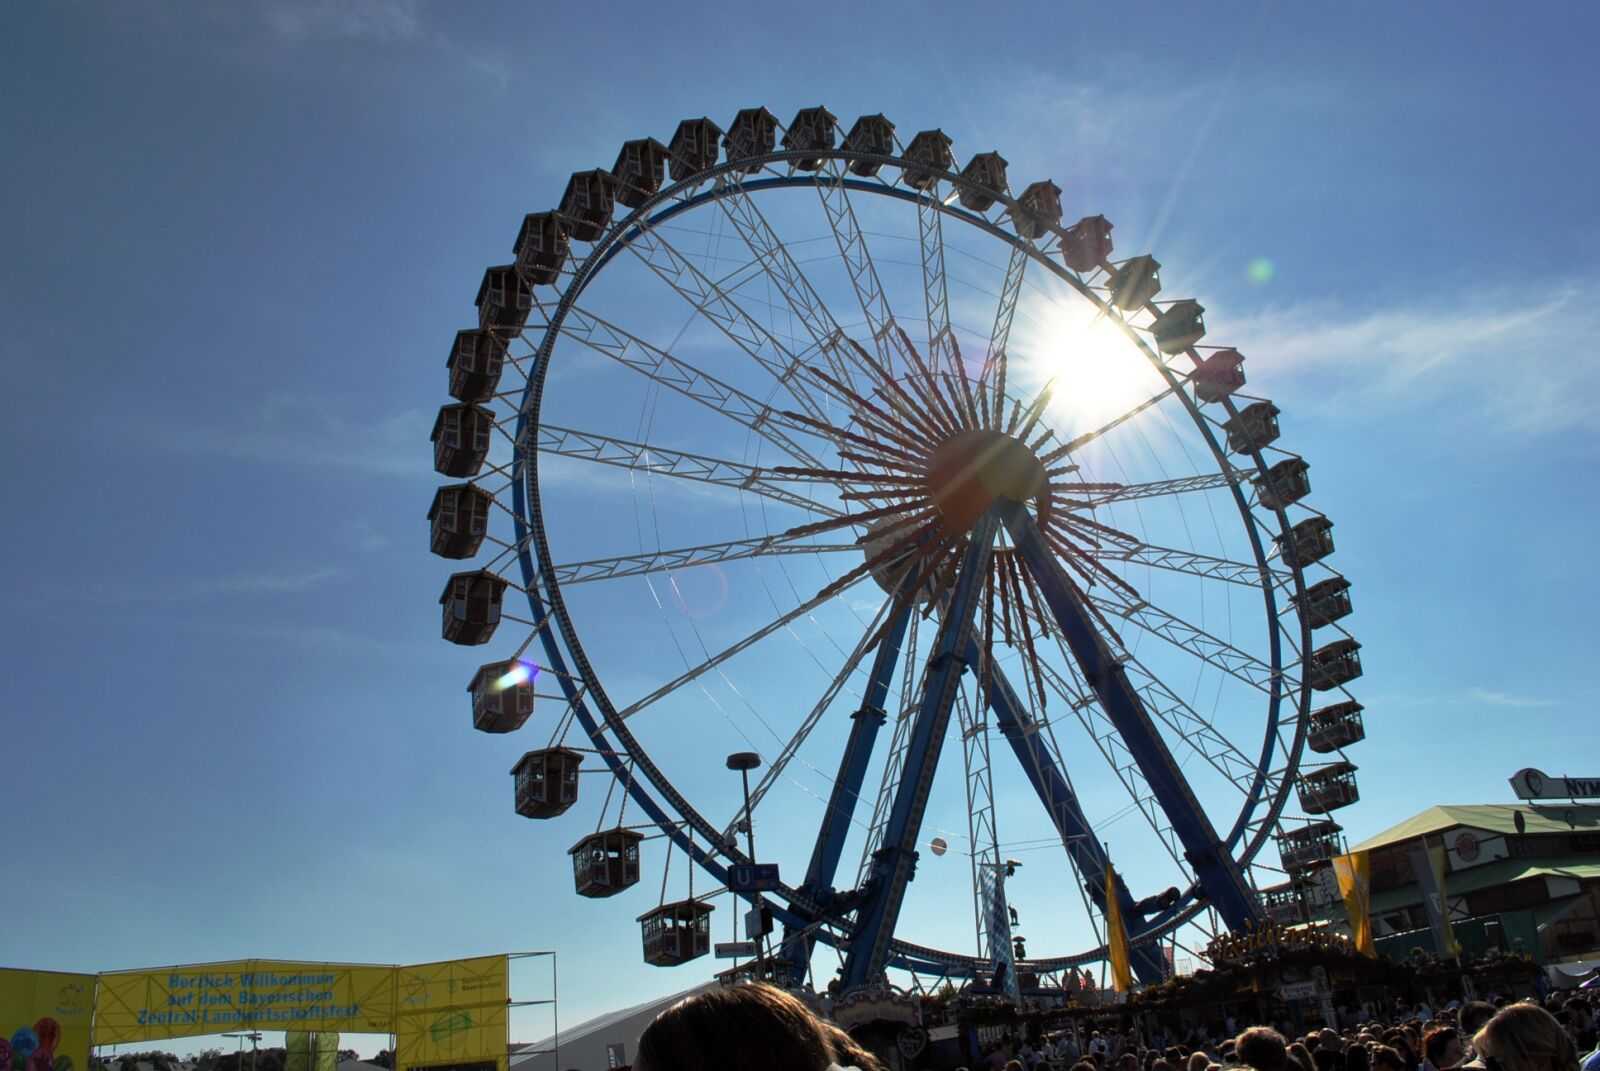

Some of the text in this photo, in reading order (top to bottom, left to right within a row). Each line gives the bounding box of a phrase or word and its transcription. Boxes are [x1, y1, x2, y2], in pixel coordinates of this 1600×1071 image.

[737, 869, 750, 886] U
[168, 972, 334, 989] Herzlich Willkommen
[167, 989, 333, 1009] auf dem Bayerischen
